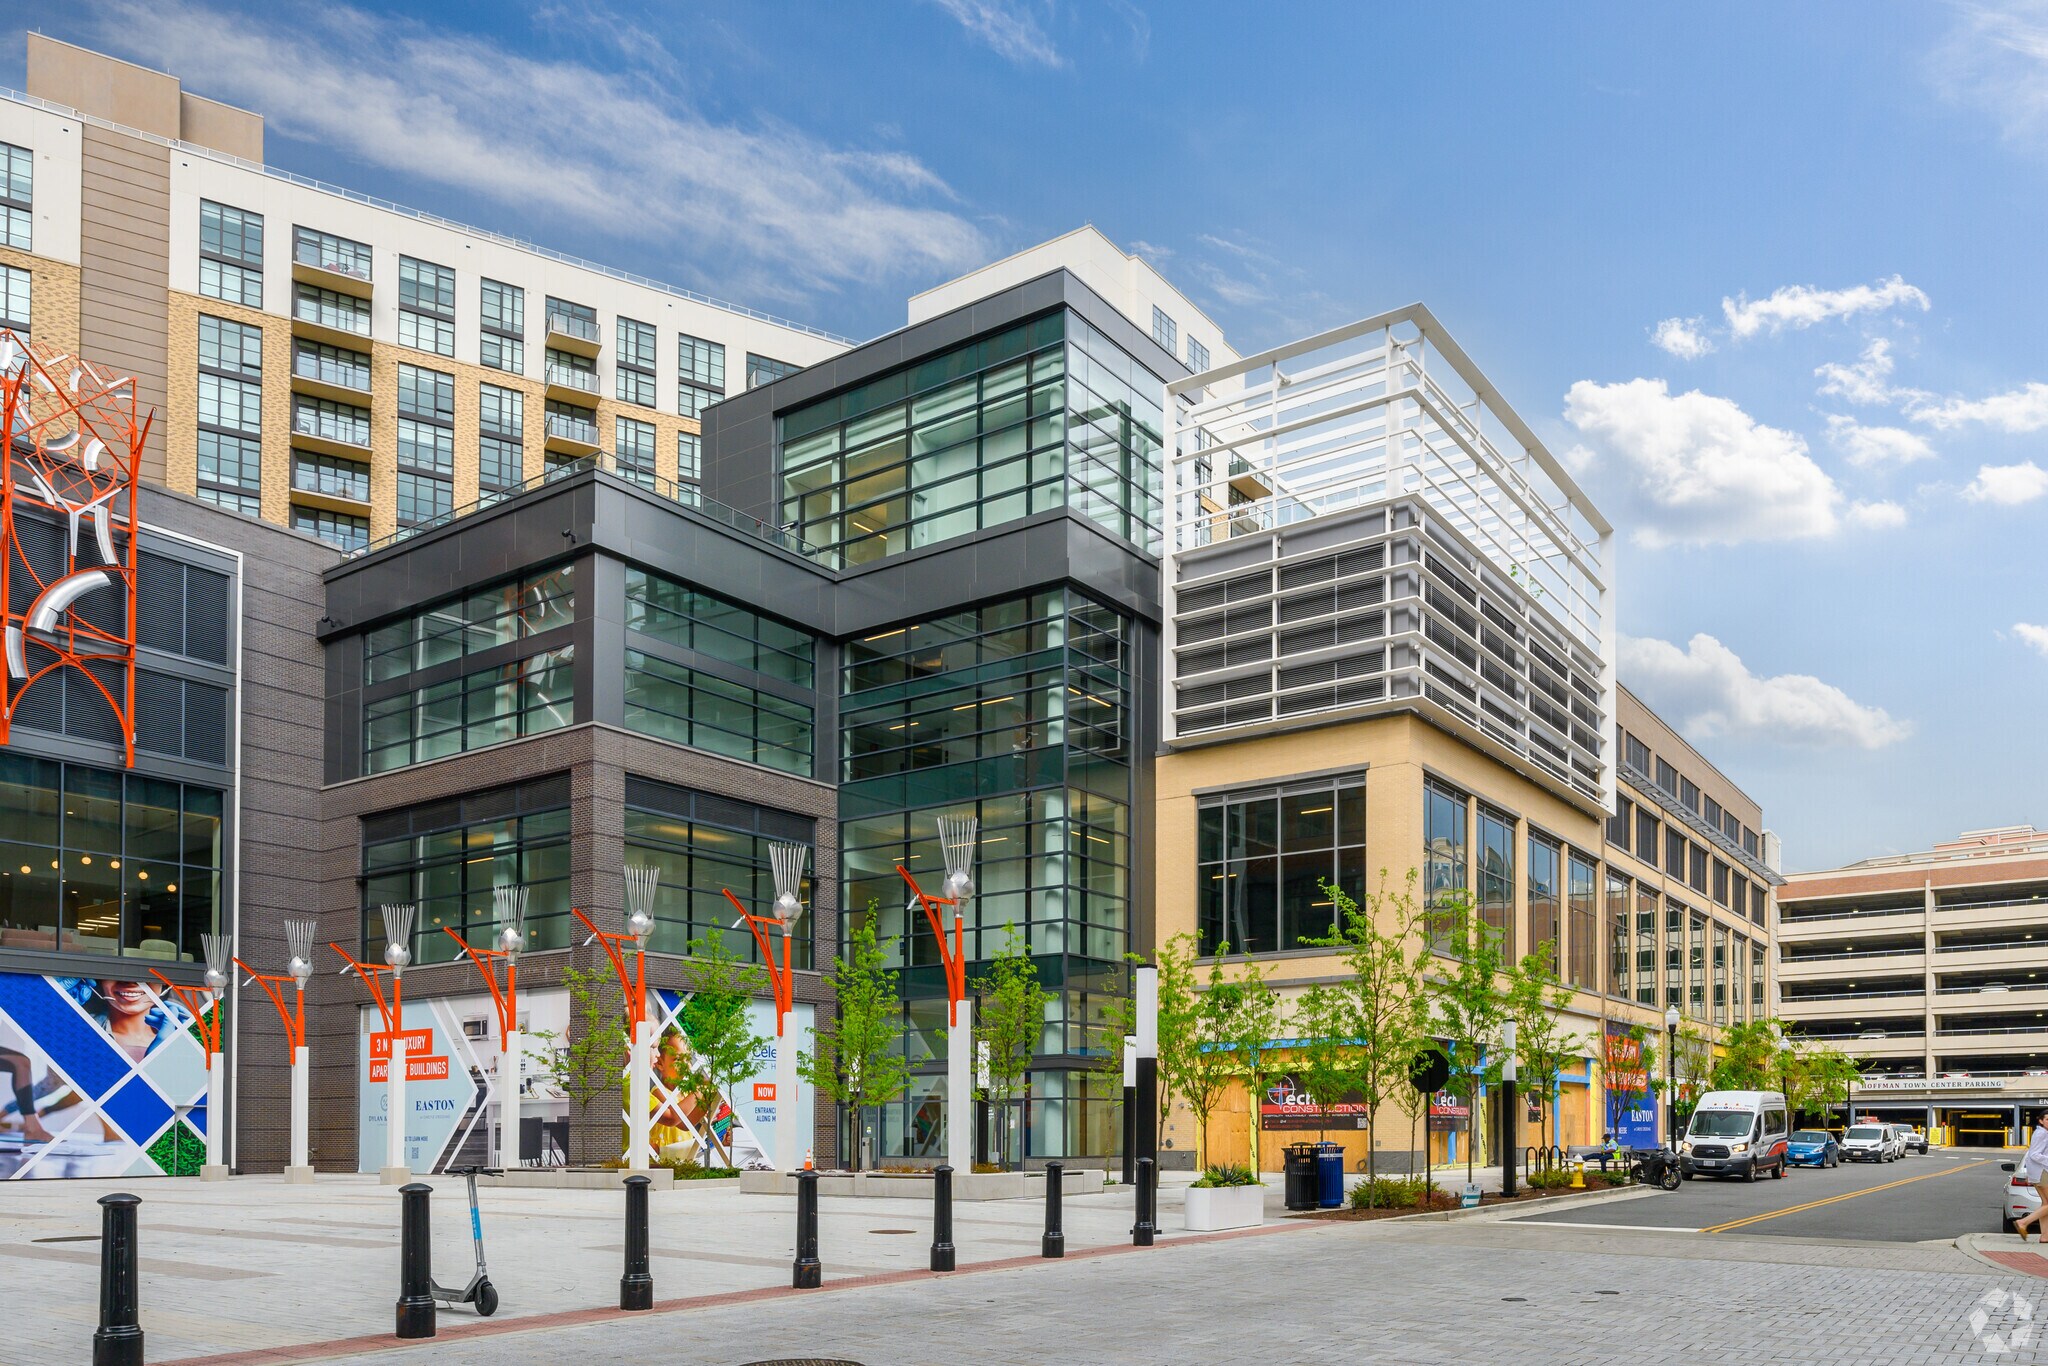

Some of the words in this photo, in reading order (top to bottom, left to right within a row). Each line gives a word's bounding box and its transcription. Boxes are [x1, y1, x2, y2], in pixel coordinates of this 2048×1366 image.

[376, 1039, 381, 1052] 3
[403, 1035, 426, 1050] UXURY
[757, 1087, 774, 1097] NOW
[415, 1099, 455, 1111] EASTON
[1282, 1105, 1367, 1113] CONSTUCTION
[1631, 1109, 1654, 1122] EASTON
